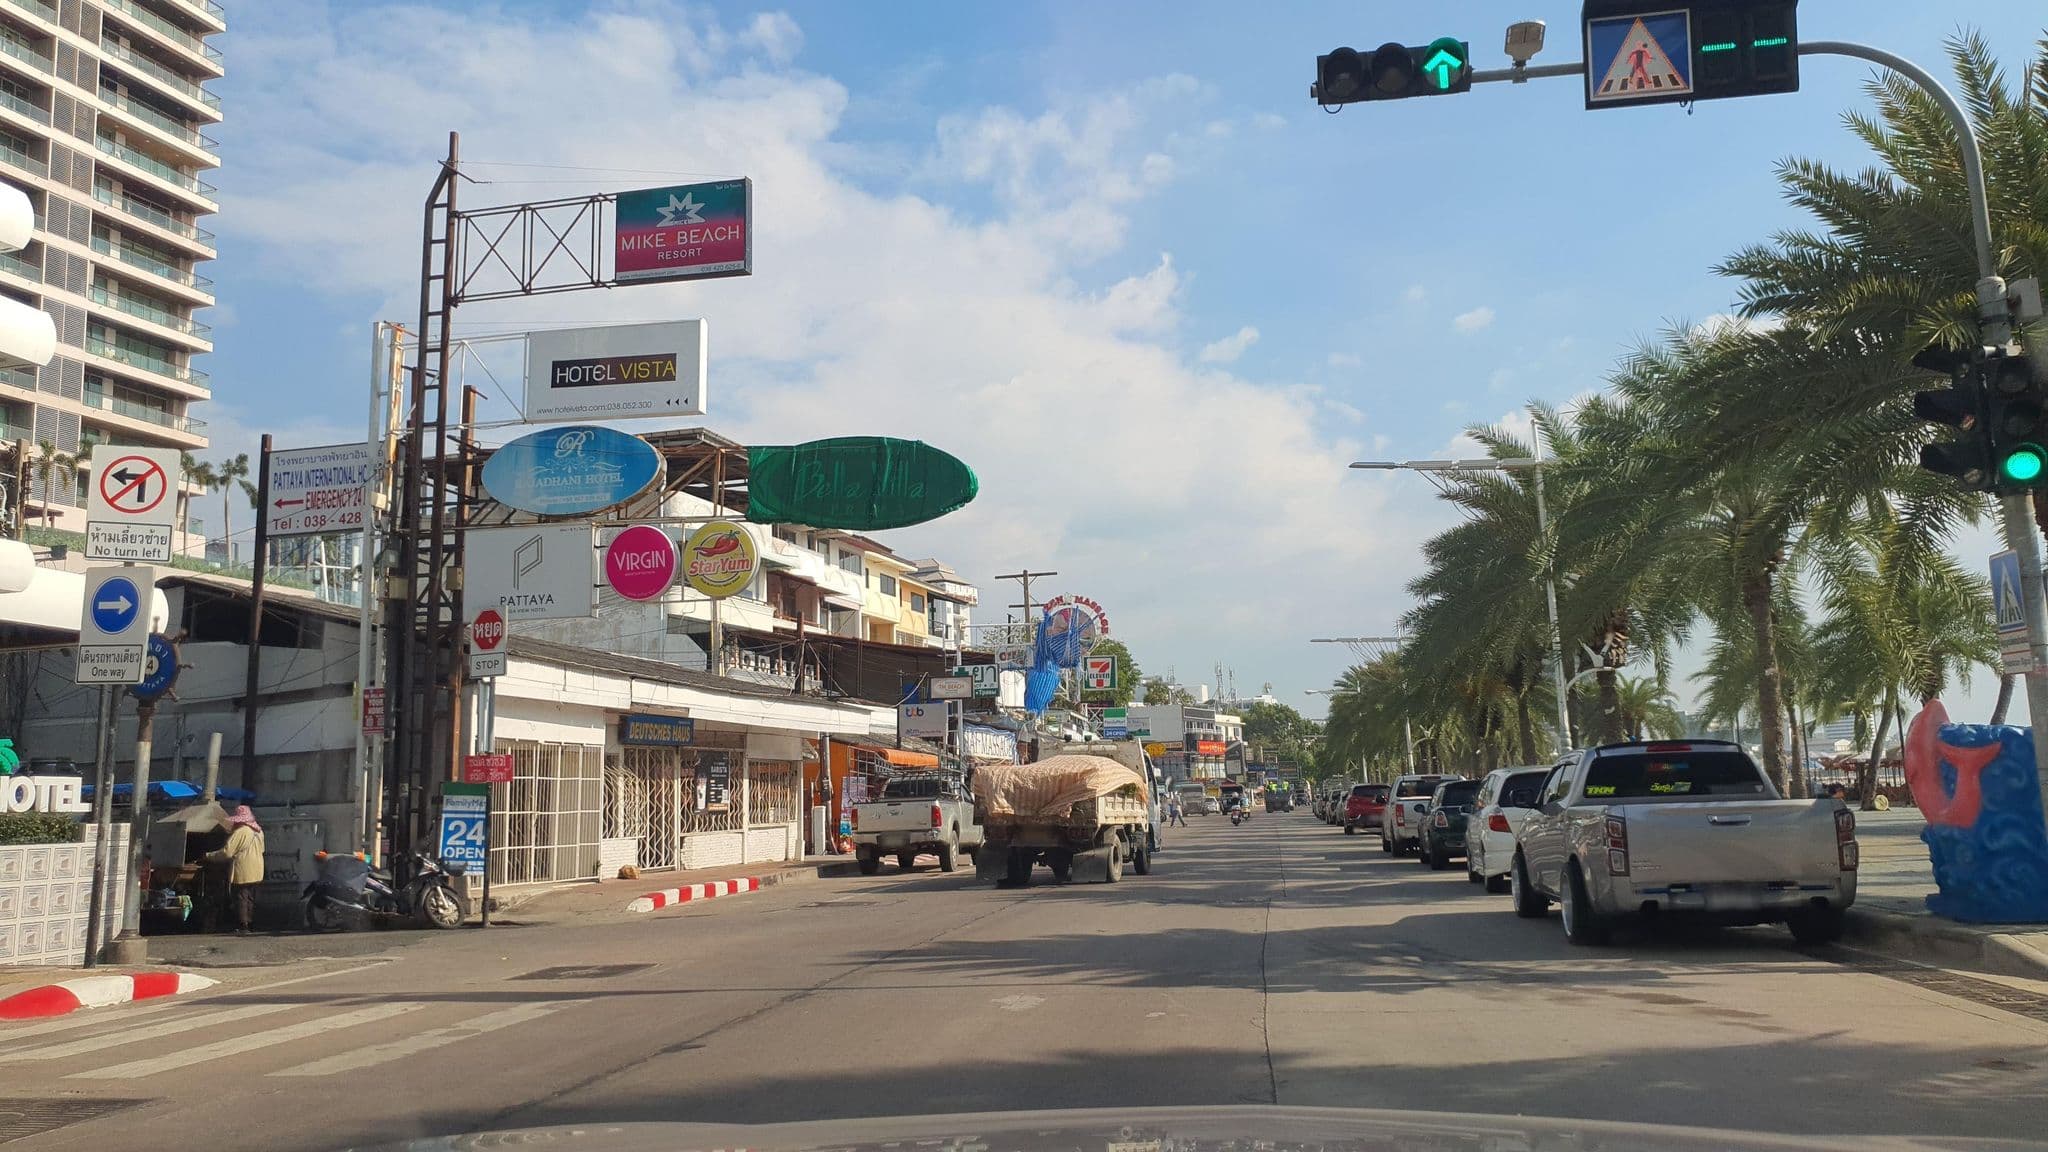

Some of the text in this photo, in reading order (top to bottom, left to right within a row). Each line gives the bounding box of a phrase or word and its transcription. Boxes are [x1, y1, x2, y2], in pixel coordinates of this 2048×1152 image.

[621, 224, 740, 251] MIKE BEACH
[657, 247, 702, 260] RESORT
[556, 360, 676, 384] HOTEL VISTA
[273, 470, 303, 491] PATTAYA
[304, 465, 356, 488] INTERNATIONAL
[586, 472, 624, 484] HOTEL
[306, 488, 352, 511] EMERGENCY
[271, 518, 292, 530] Tel
[304, 515, 326, 528] 038
[90, 525, 168, 546] ห้ามเลี้ยวซ้าย
[94, 545, 162, 558] No turn left
[614, 550, 666, 570] VIRGIN
[500, 594, 554, 606] PATTAYA
[474, 622, 502, 644] หยุด
[91, 666, 126, 679] One way
[475, 659, 500, 671] STOP
[972, 665, 997, 683] ยา
[629, 721, 691, 743] DEUTSCHES HAUS
[446, 820, 486, 846] 24
[444, 846, 485, 859] OPEN
